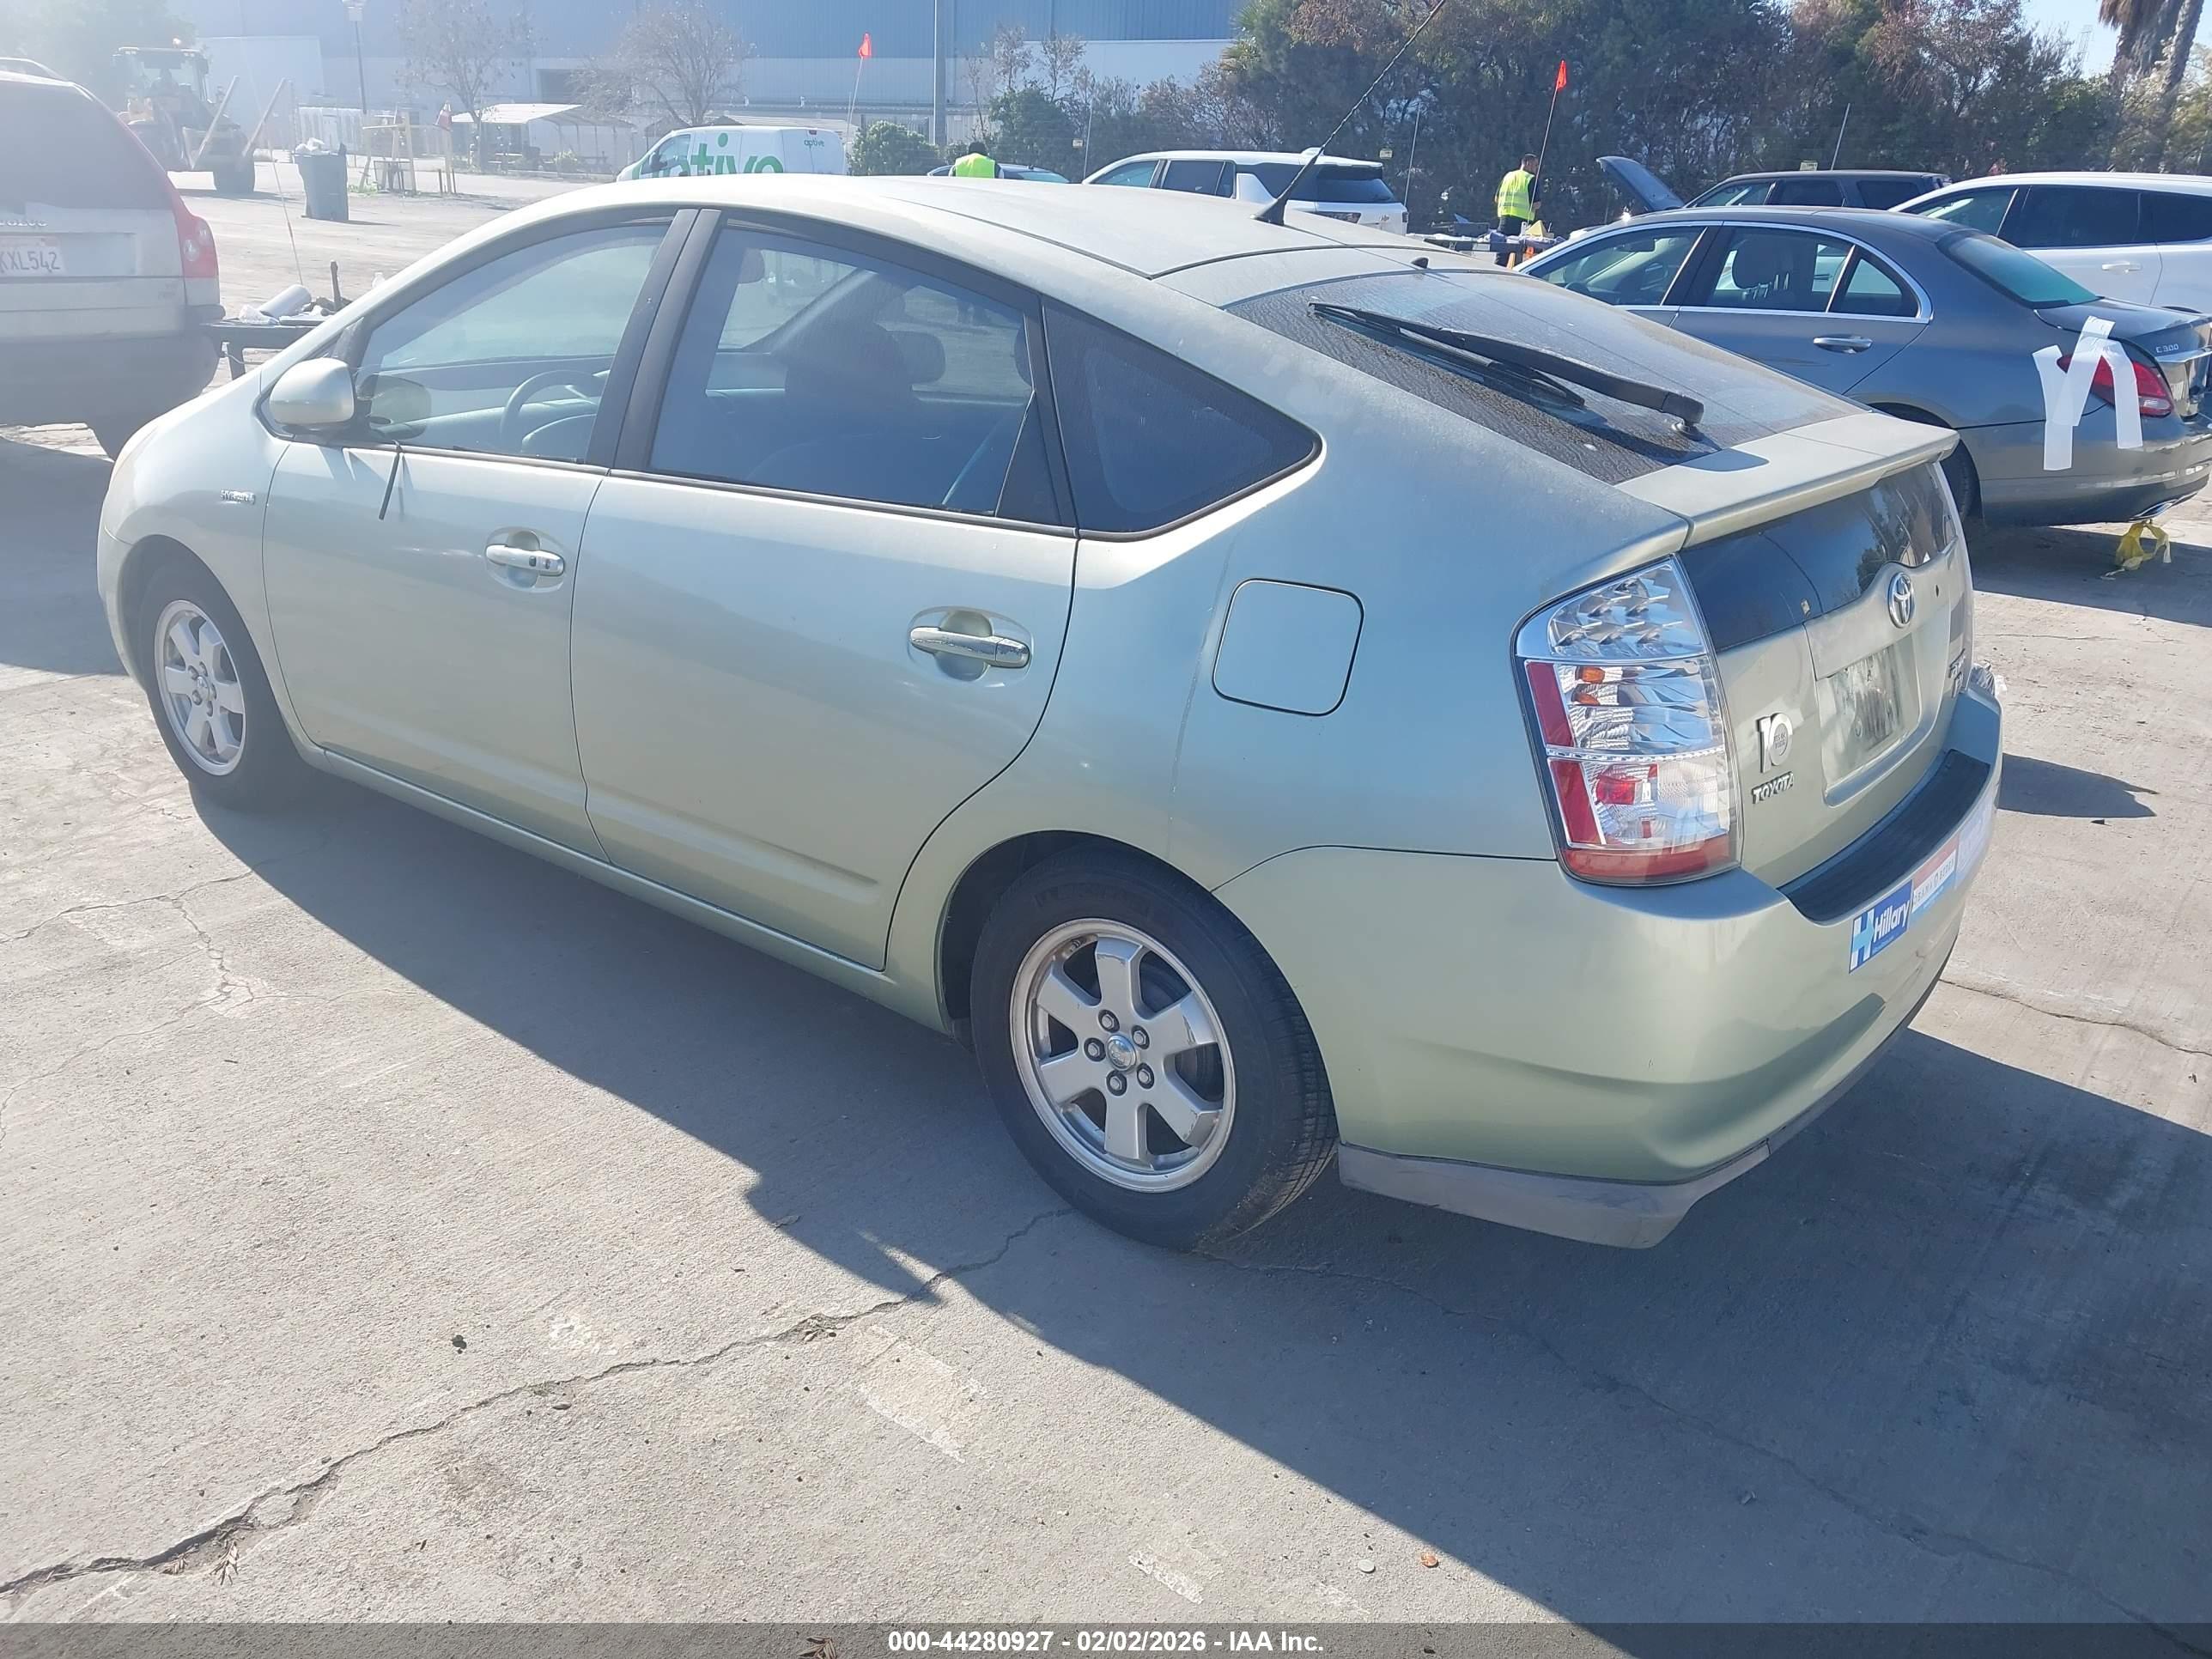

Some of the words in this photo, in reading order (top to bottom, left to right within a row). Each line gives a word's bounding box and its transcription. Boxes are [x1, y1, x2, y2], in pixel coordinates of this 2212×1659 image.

[804, 137, 824, 149] aptive
[1752, 771, 1795, 804] TOYOTA
[1874, 900, 1911, 943] Hillary
